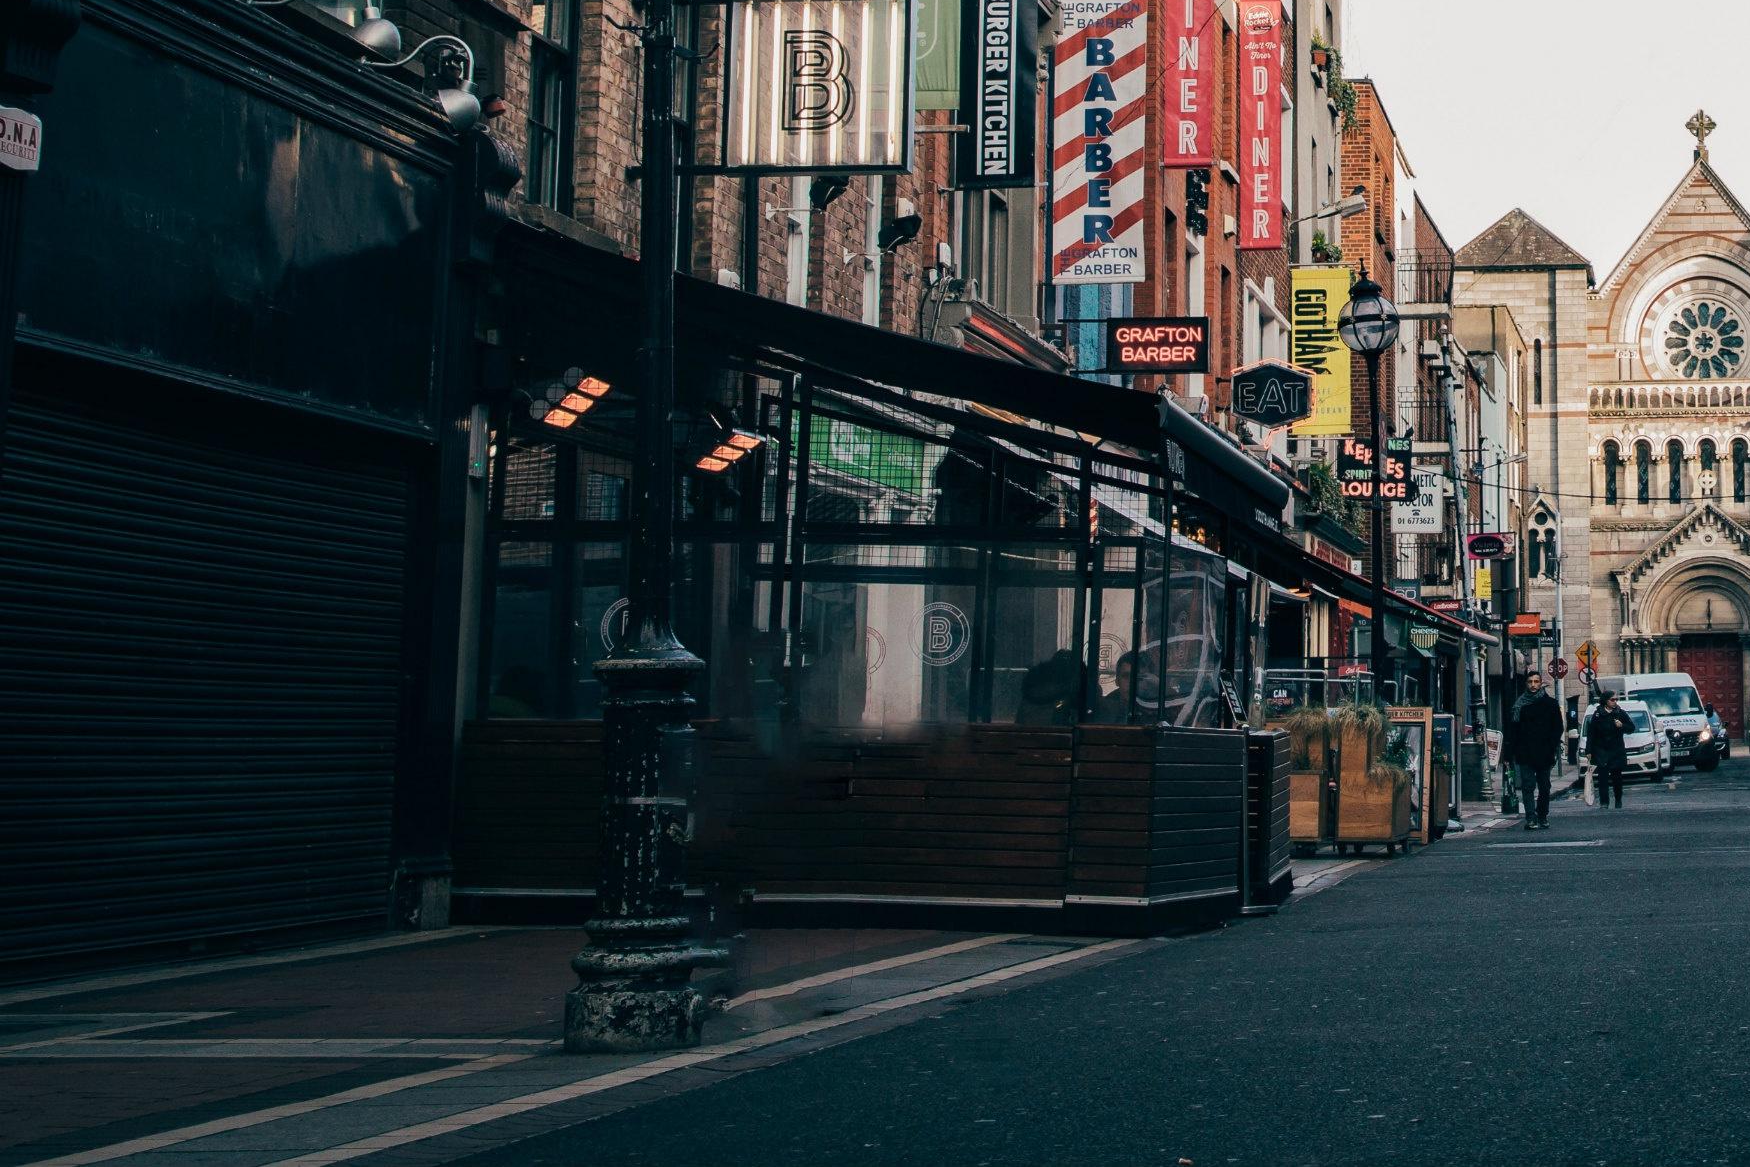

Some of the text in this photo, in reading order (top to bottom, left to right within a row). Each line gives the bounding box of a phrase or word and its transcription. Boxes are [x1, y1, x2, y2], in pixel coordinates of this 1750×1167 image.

[1063, 2, 1074, 29] THE
[1075, 2, 1140, 13] GRAFTON
[1077, 18, 1134, 29] BARBER
[984, 79, 1009, 176] KITCHEN
[1082, 37, 1118, 245] BARBER
[0, 139, 37, 162] ECURITY
[1251, 65, 1270, 240] DINER
[1072, 247, 1138, 259] GRAFTON
[1074, 264, 1132, 276] BARBER
[1115, 326, 1203, 344] GRAFTON
[1121, 346, 1196, 362] BARBER
[1237, 377, 1304, 414] EAT
[1387, 438, 1410, 451] NES
[1344, 469, 1373, 480] SPIRIT
[1340, 481, 1406, 498] LOUGE
[1397, 517, 1405, 525] 01
[1549, 664, 1567, 673] SOP
